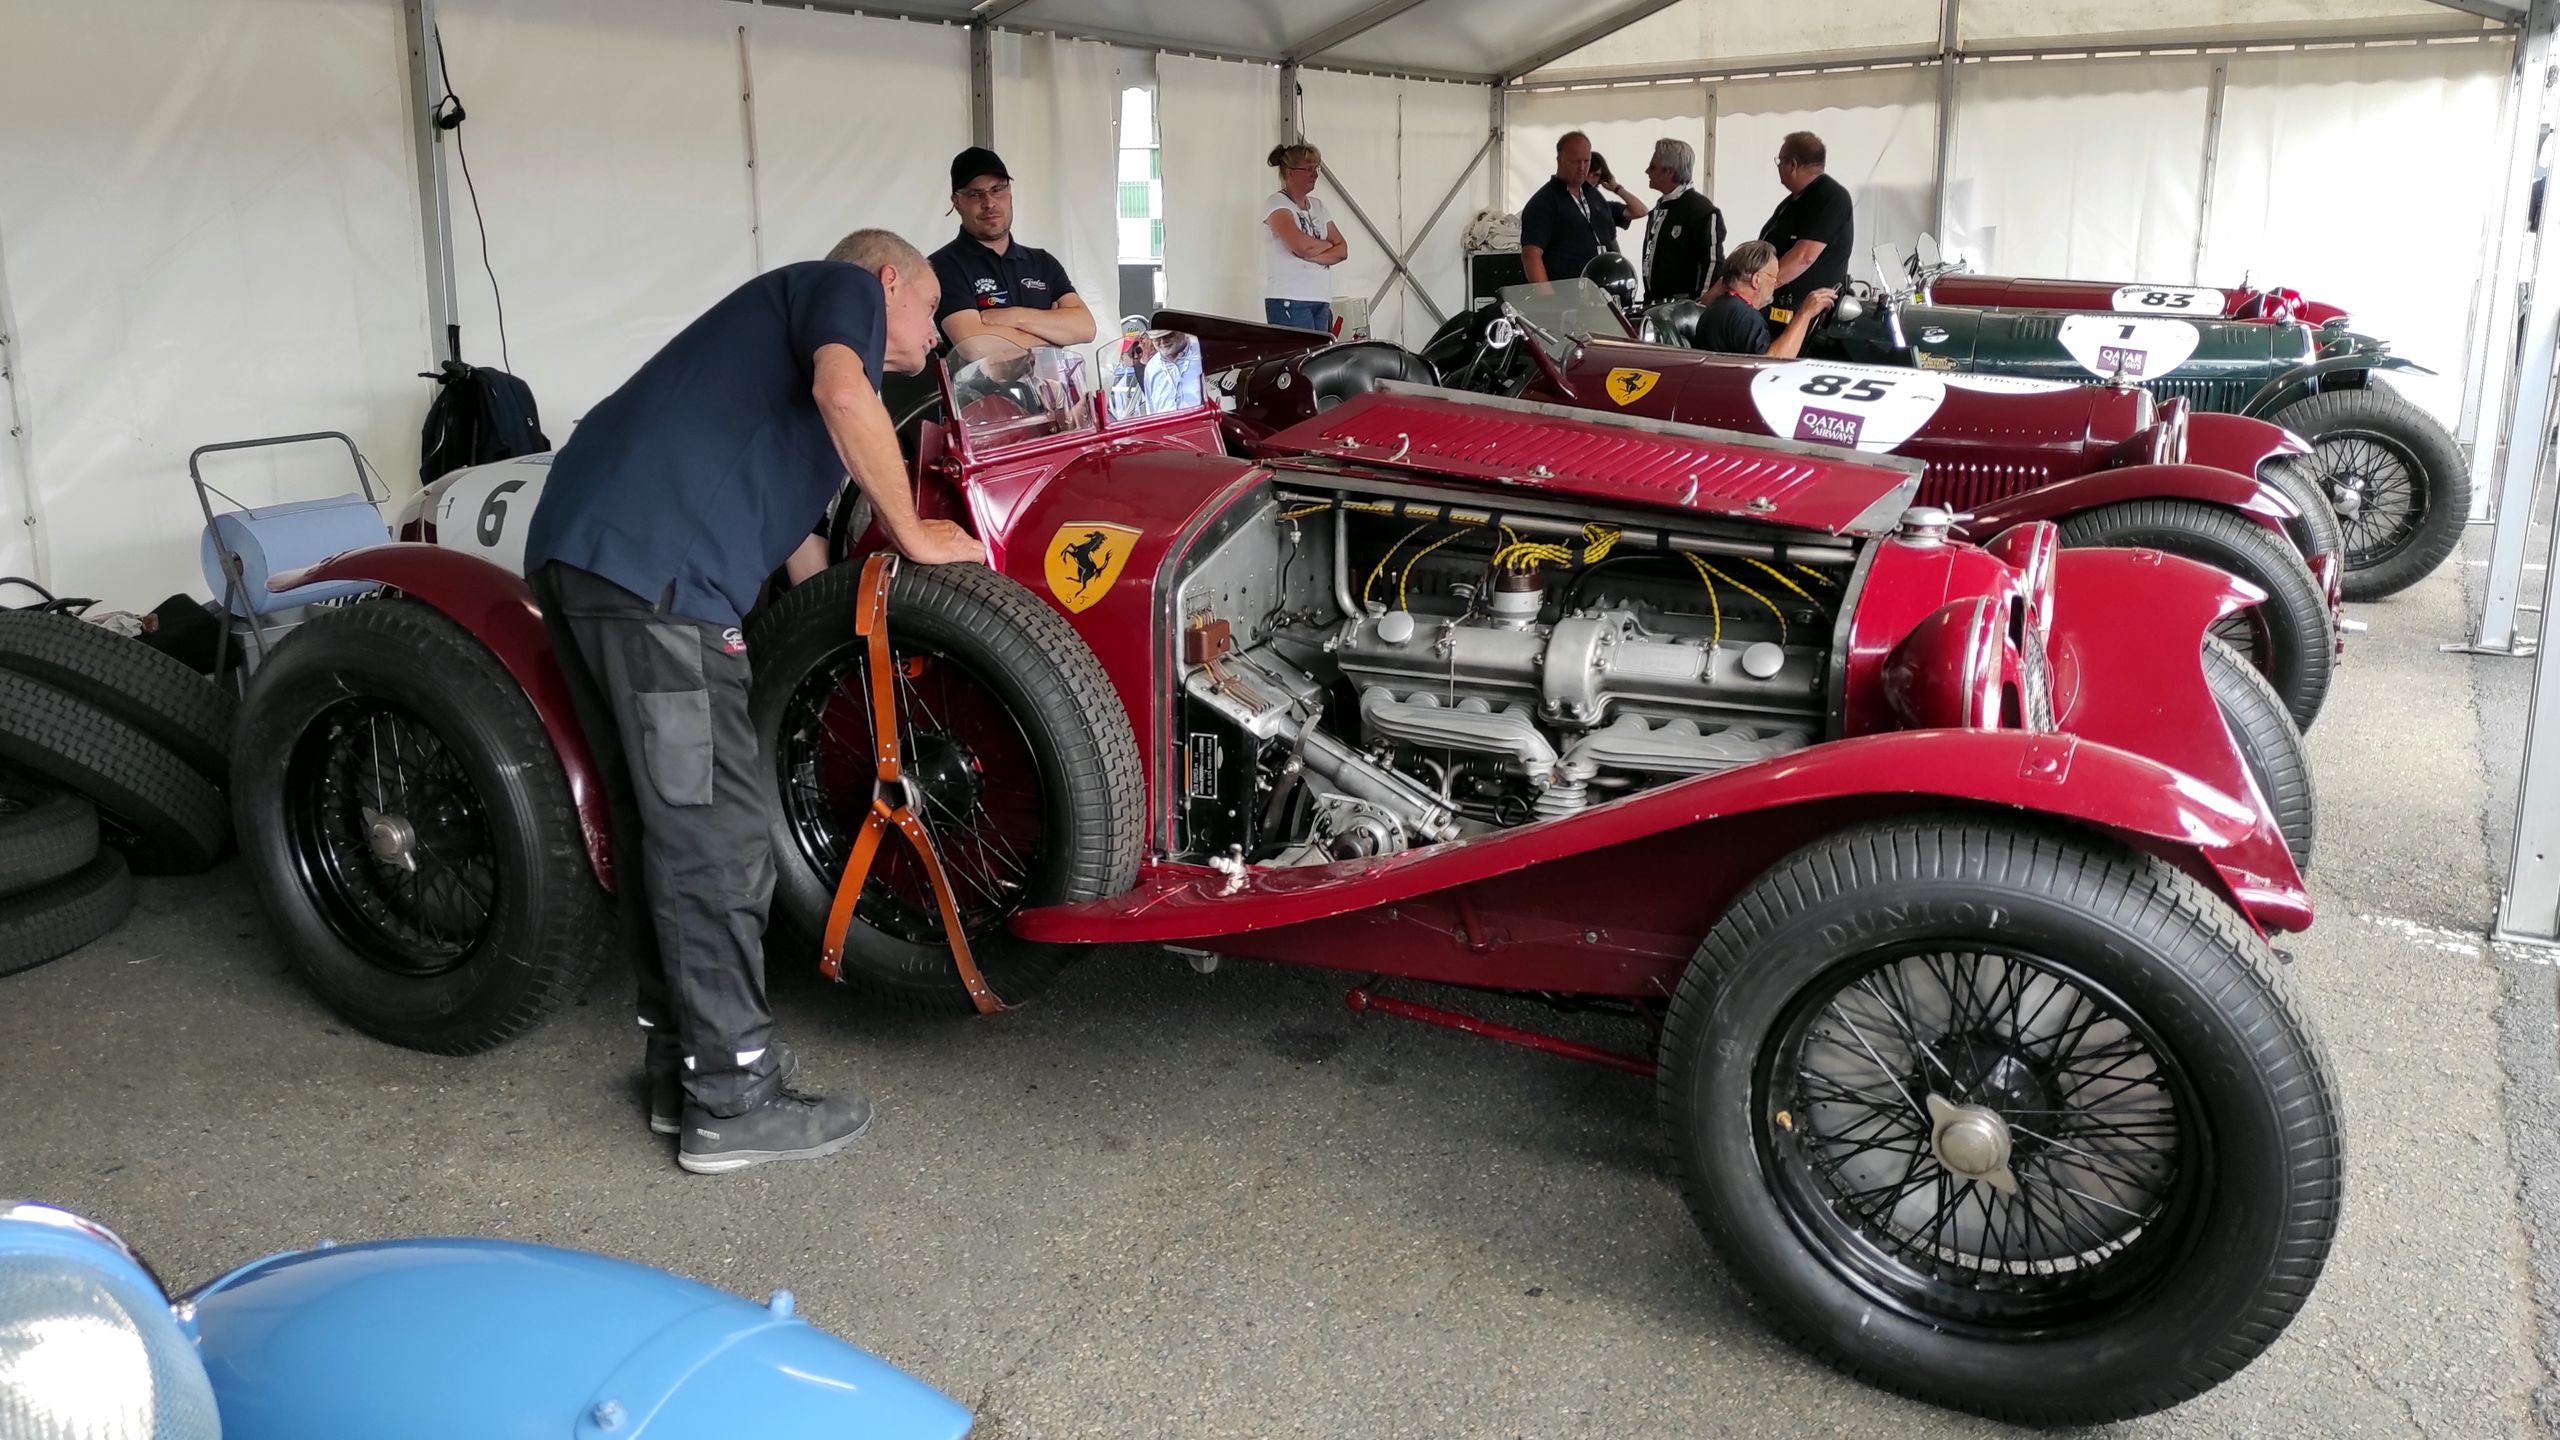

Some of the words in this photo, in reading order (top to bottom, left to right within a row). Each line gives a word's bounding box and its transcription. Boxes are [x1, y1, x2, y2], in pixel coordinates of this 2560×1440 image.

[2141, 292, 2195, 308] 83
[2118, 324, 2136, 339] 1
[2102, 350, 2143, 364] QAAR
[1799, 375, 1897, 402] 85
[1803, 412, 1857, 435] QATAR
[1812, 426, 1854, 445] AIRWAYS
[477, 480, 528, 547] 6
[1816, 900, 2011, 948] DUNLOP
